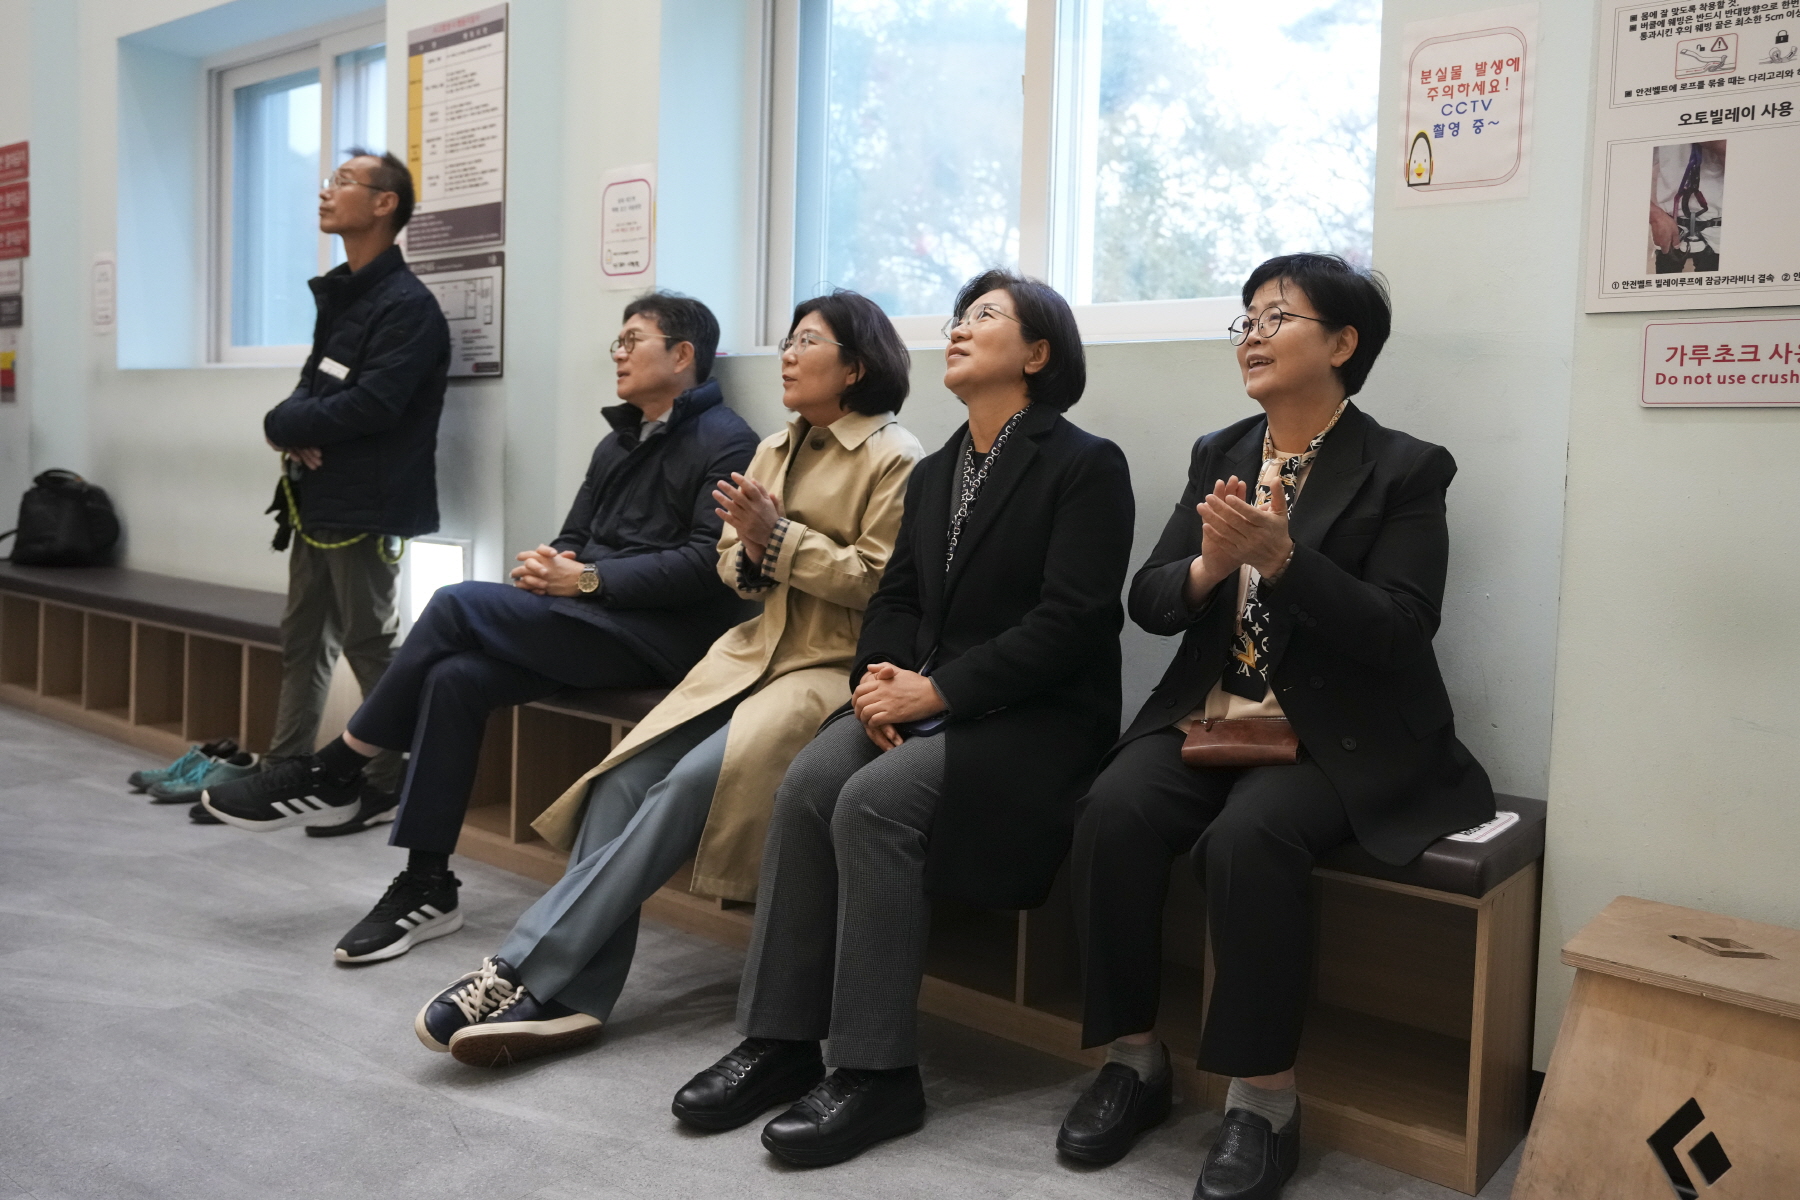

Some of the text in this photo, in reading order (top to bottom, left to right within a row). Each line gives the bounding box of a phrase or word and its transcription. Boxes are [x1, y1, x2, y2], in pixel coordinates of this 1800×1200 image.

[1660, 8, 1668, 18] 잘
[1696, 11, 1722, 22] 반드시
[1725, 2, 1778, 18] 반대방향으로
[1675, 25, 1692, 35] 후의
[1735, 15, 1762, 26] 최소한
[1765, 14, 1784, 22] 5cm
[1420, 56, 1520, 84] 분실물 발생에
[1680, 80, 1706, 91] 로프를
[1728, 76, 1746, 86] 때는
[1748, 69, 1794, 83] 다리고리와
[1427, 77, 1509, 101] 주의하세요!
[1441, 98, 1493, 116] CCTV
[1678, 101, 1794, 126] 오토빌레이 사용
[1433, 121, 1460, 139] 촬영
[1665, 344, 1760, 366] 가루초크
[1656, 370, 1800, 385] Do not use crush
